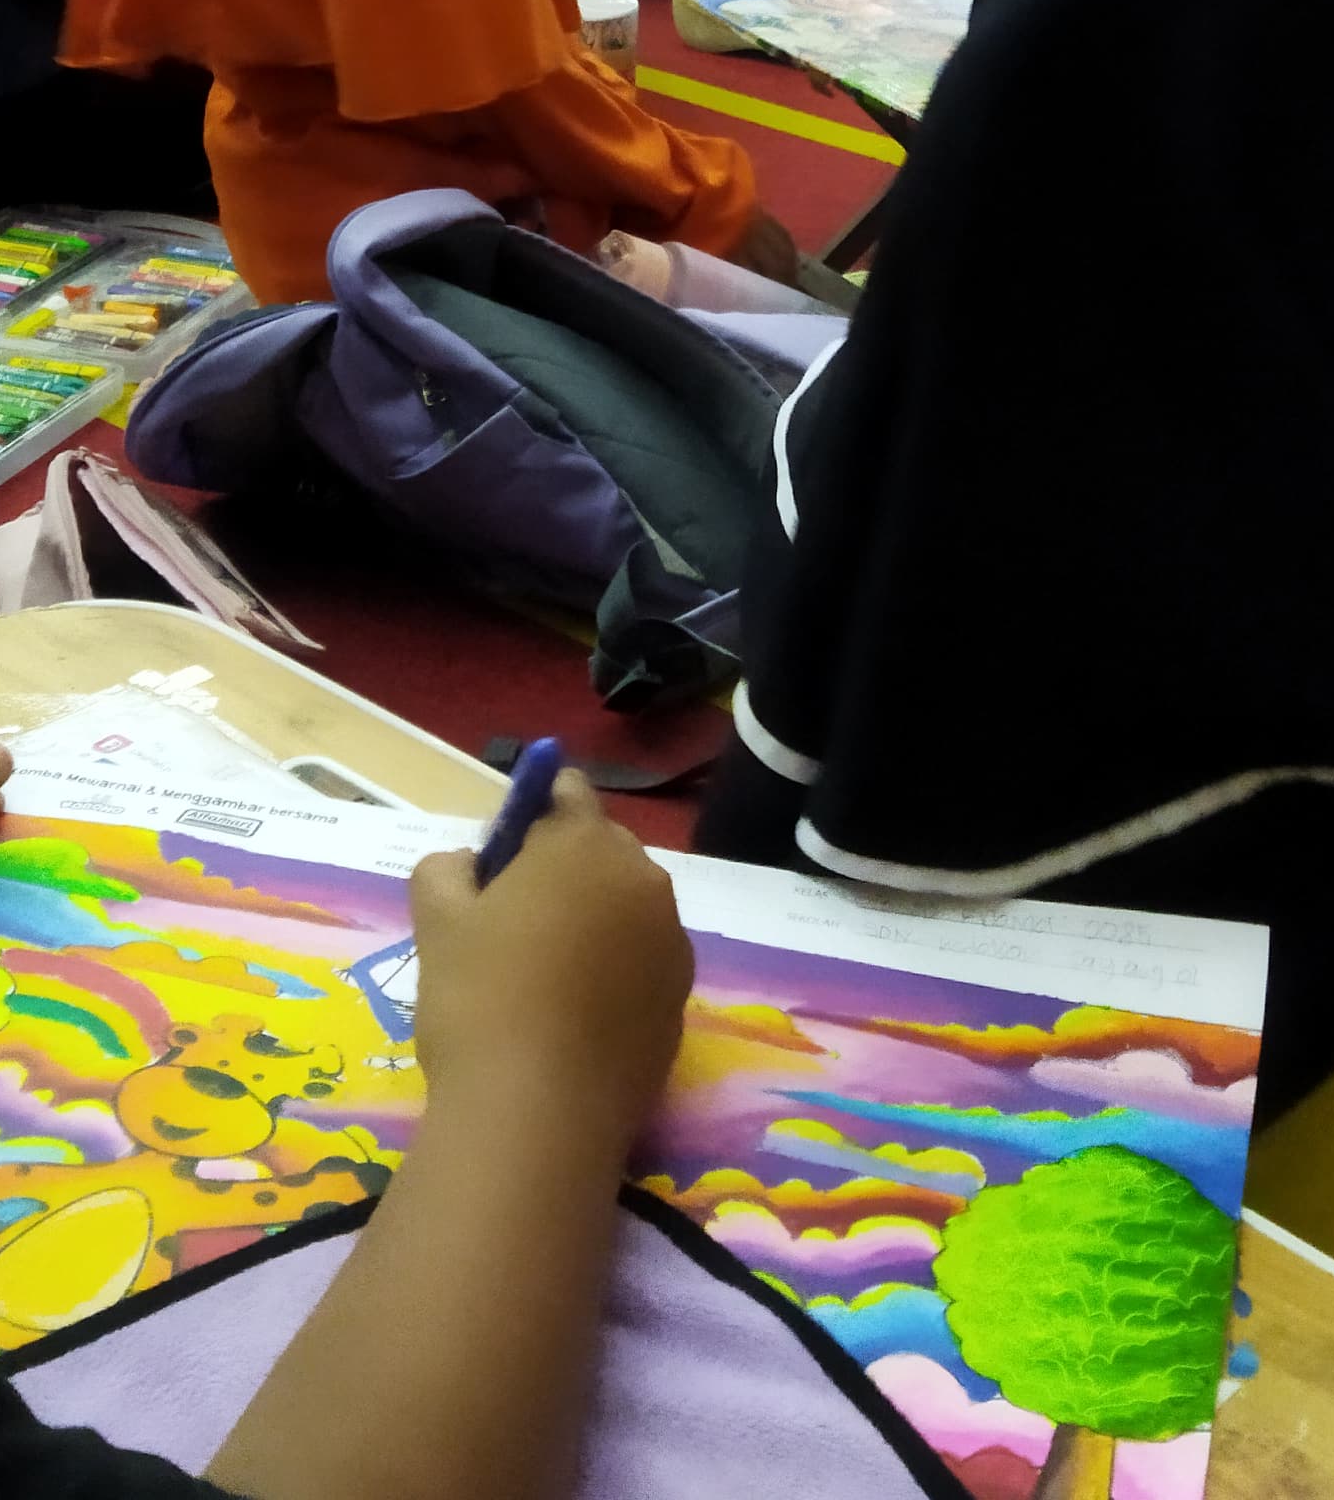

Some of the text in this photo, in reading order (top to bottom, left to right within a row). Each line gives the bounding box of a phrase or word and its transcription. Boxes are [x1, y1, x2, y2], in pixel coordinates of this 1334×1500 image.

[66, 773, 141, 793] Mewarnai
[161, 788, 266, 814] Menggambar
[269, 805, 339, 825] bersama
[186, 809, 254, 829] Alfamart
